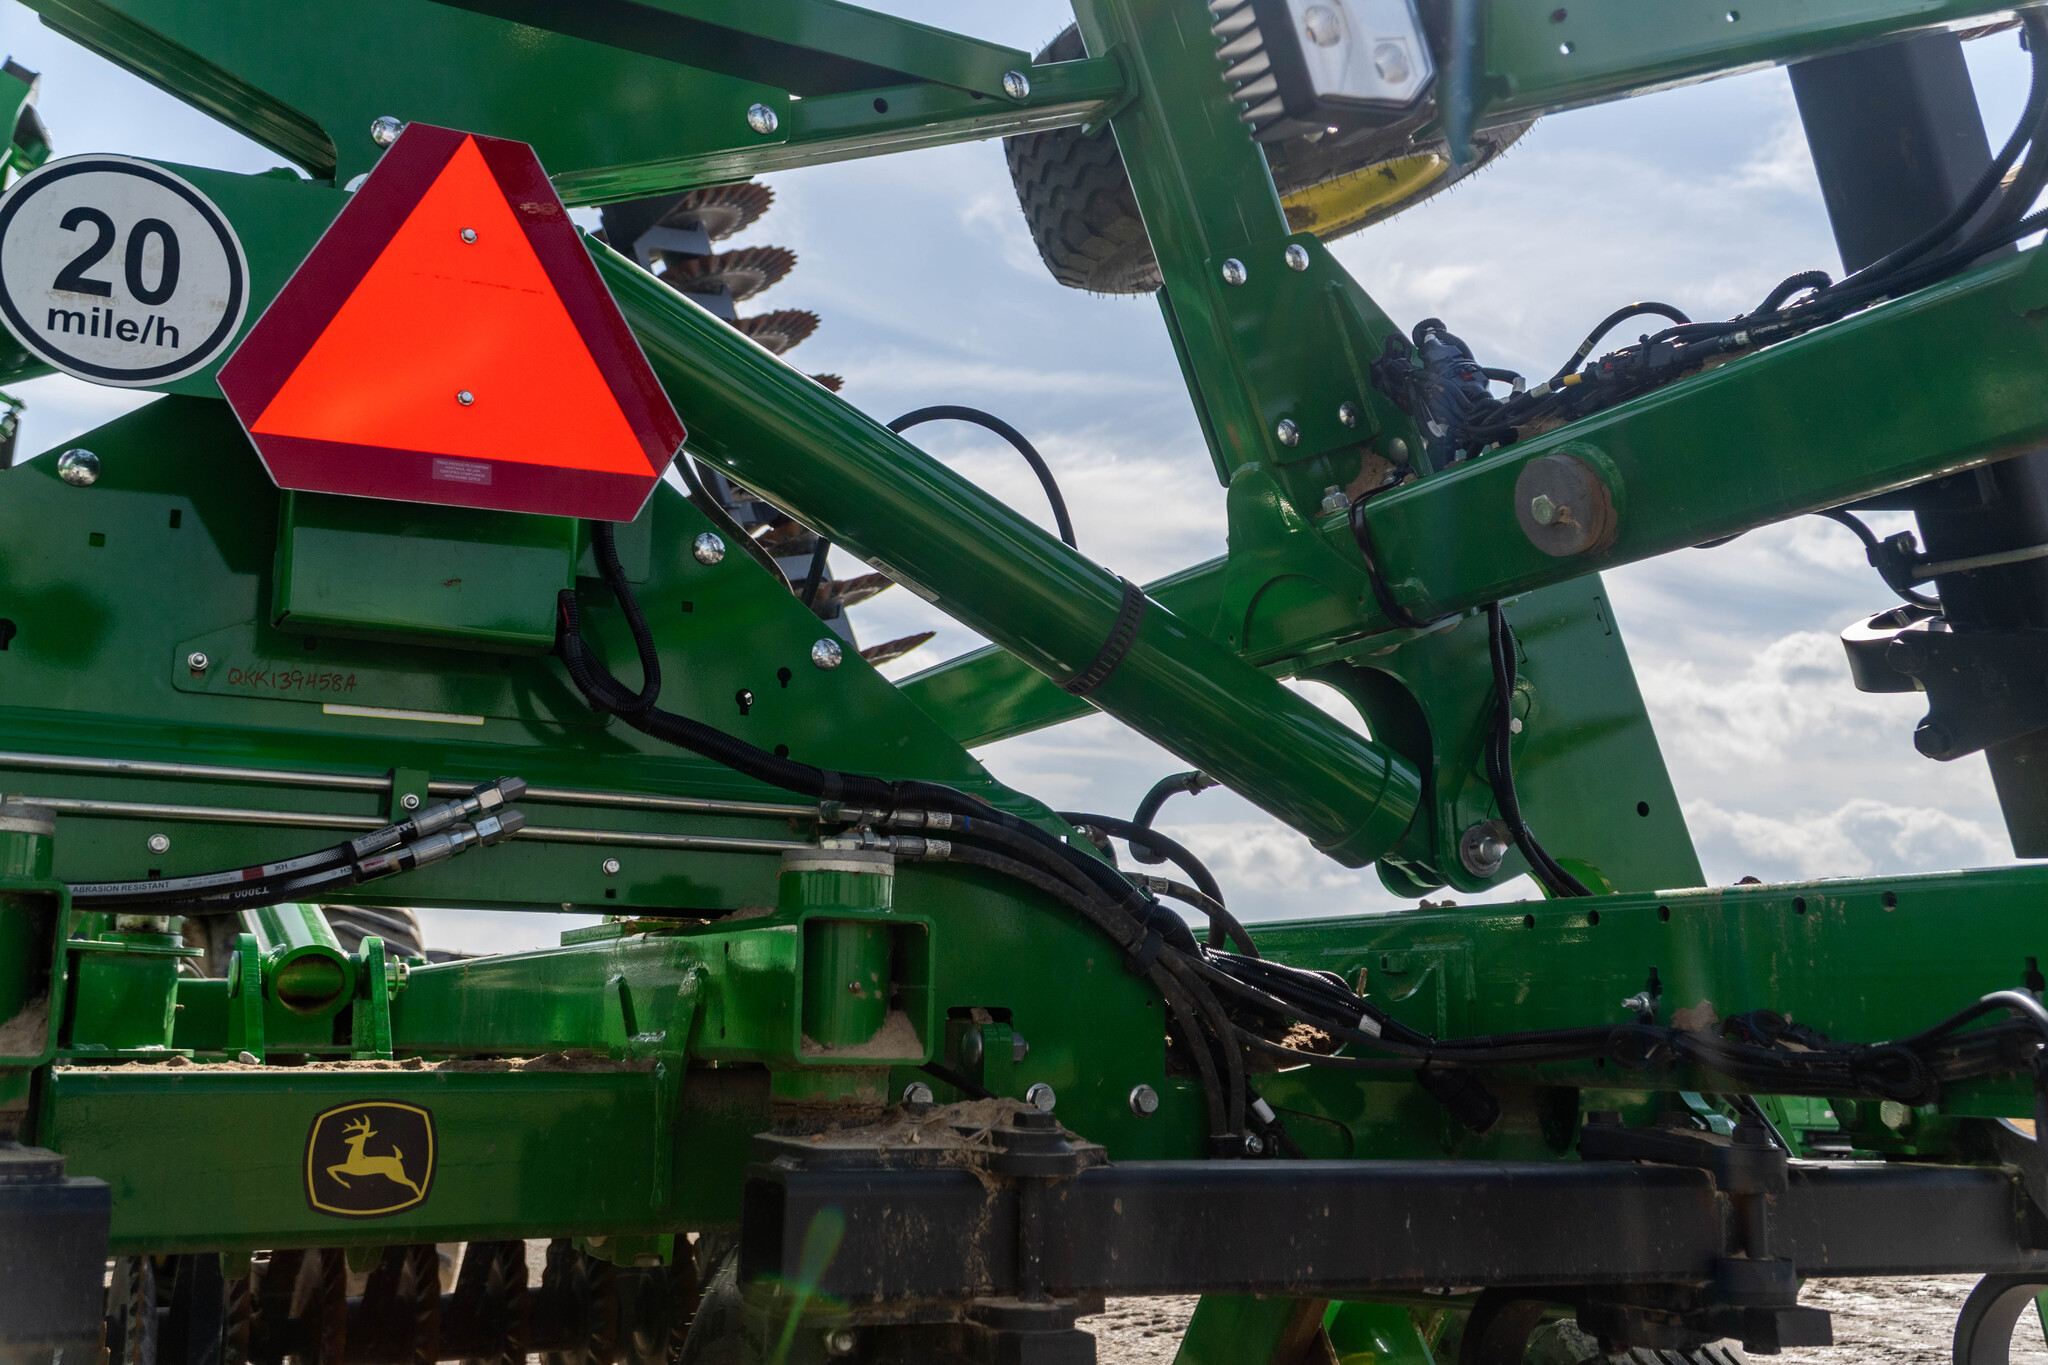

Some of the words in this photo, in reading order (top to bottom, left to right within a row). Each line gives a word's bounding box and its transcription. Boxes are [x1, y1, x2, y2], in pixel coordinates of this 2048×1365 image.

[52, 206, 181, 306] 20
[47, 306, 180, 348] mile/h
[227, 667, 358, 693] QKK139458A
[72, 883, 119, 893] ABRASION
[121, 881, 170, 891] RESISTANT
[234, 886, 270, 899] T3000
